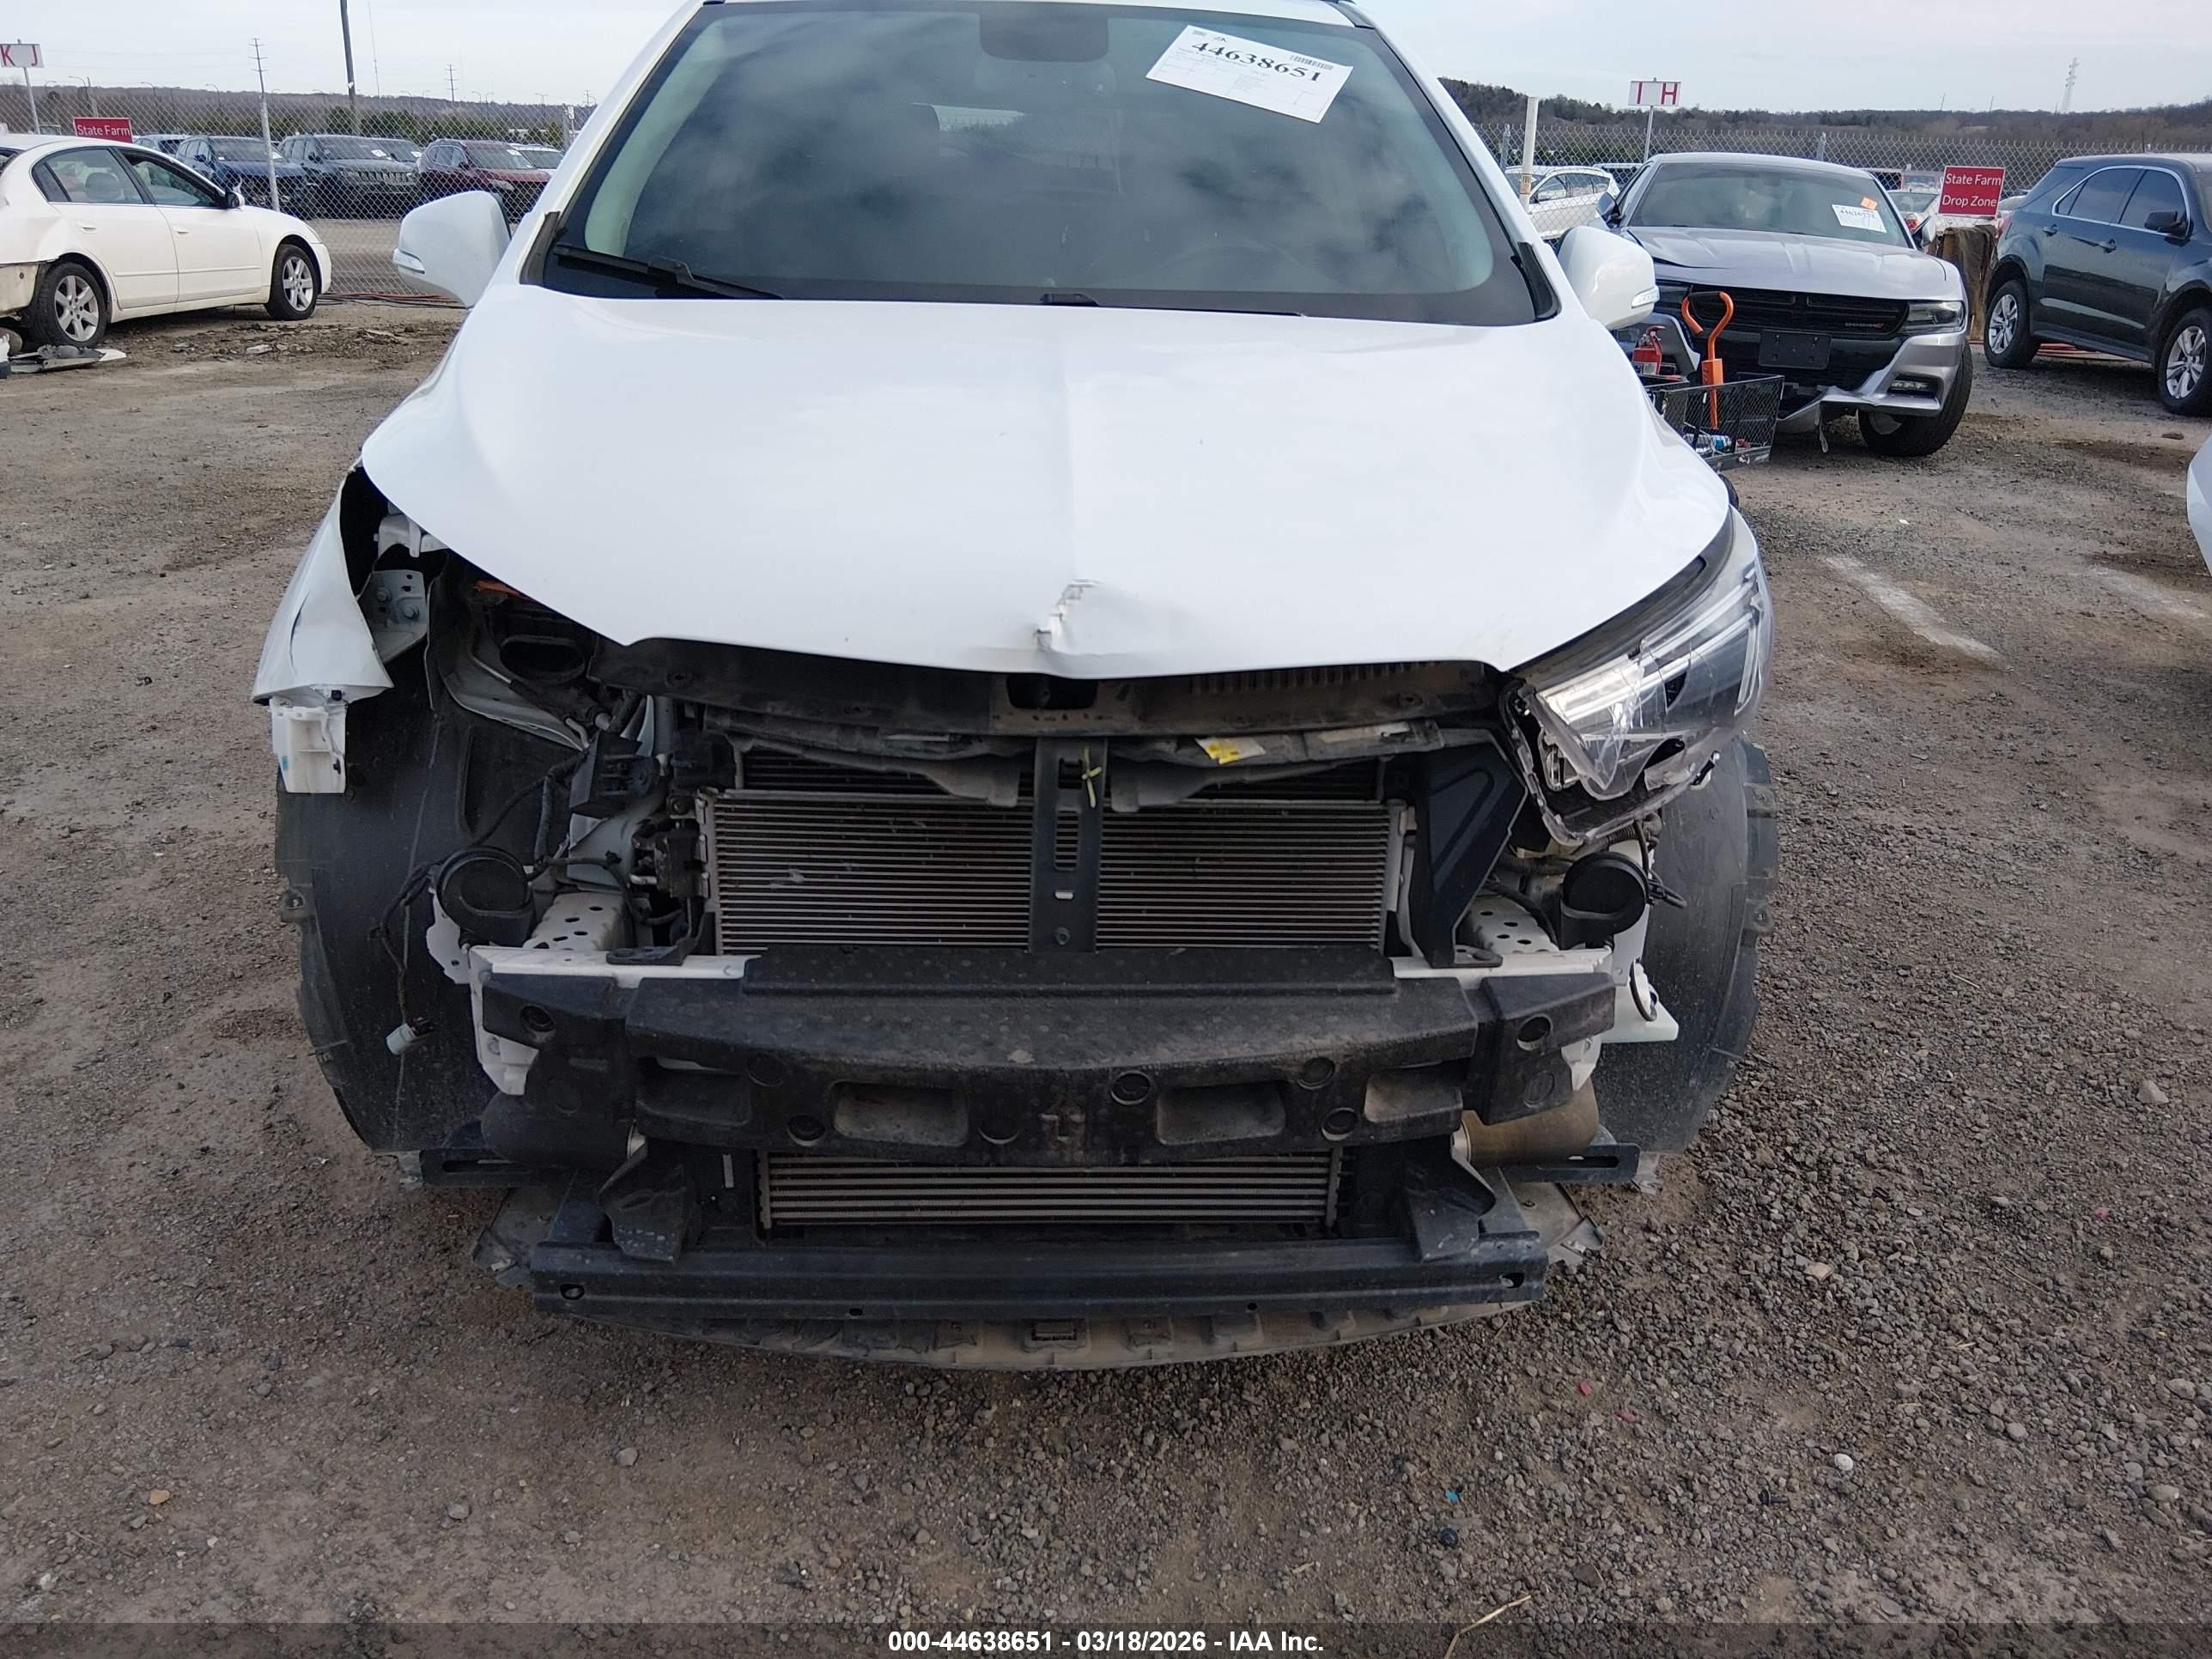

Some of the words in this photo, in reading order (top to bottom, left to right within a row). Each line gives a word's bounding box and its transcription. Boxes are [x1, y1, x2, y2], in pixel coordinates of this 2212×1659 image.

[0, 45, 15, 66] K
[31, 45, 38, 66] J
[1192, 42, 1322, 82] 44638651
[1661, 82, 1678, 105] H
[77, 125, 103, 136] State
[105, 125, 131, 137] Farm
[1945, 173, 1973, 185] State
[1975, 174, 2002, 185] Farm
[1942, 195, 1969, 208] Drop
[1971, 196, 1997, 207] Zone
